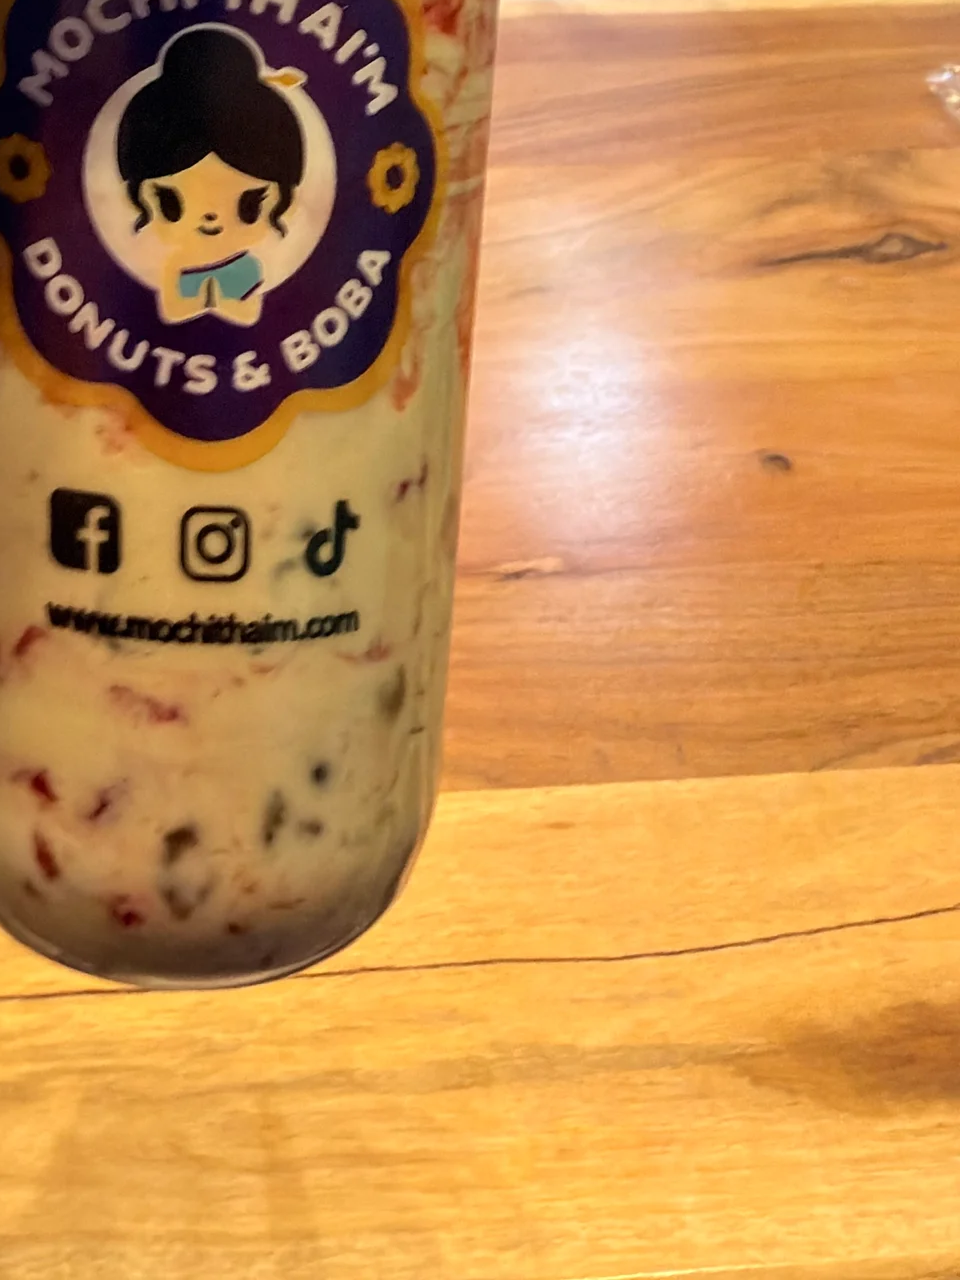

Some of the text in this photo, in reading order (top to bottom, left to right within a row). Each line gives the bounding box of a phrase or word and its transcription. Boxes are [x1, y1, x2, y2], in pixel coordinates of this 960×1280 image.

[21, 235, 392, 397] DONUTS & BOBA
[44, 600, 360, 645] www.mochithaim.com
